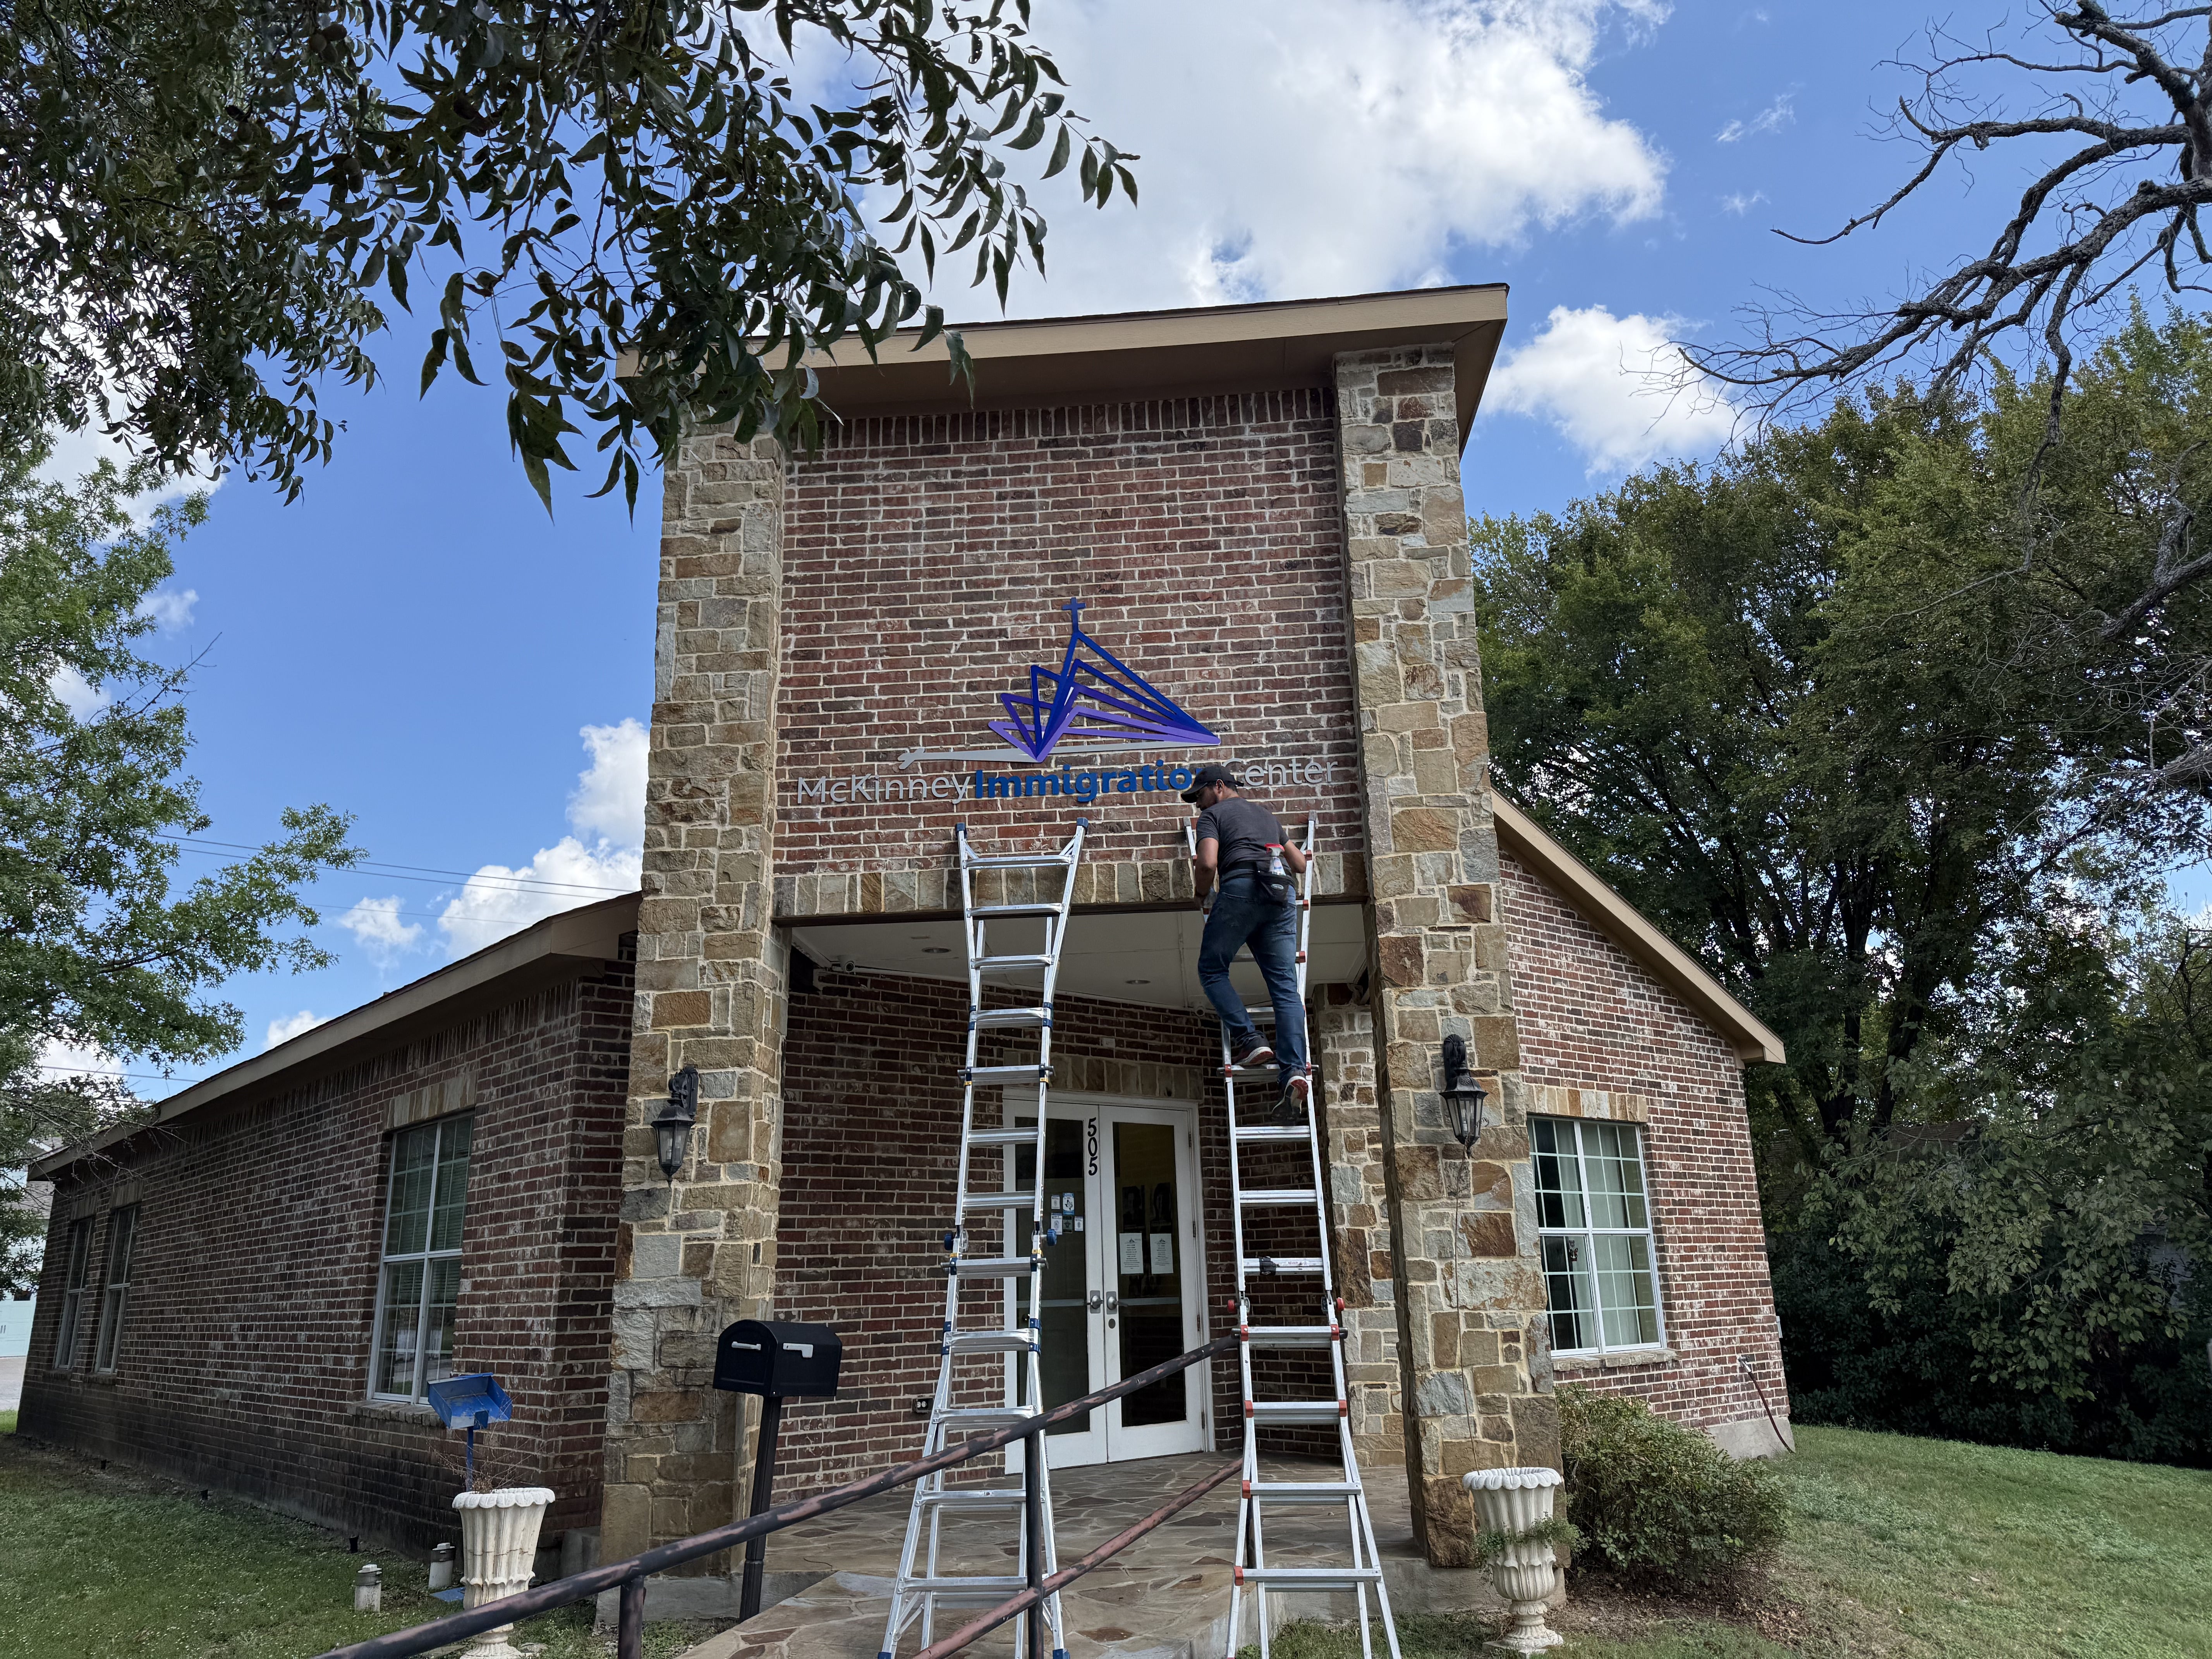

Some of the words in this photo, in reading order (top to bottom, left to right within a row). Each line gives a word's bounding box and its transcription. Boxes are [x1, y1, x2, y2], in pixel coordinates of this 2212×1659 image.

[797, 773, 971, 804] McKinney
[975, 759, 1202, 802] Immigratio
[1087, 1117, 1098, 1176] 505
